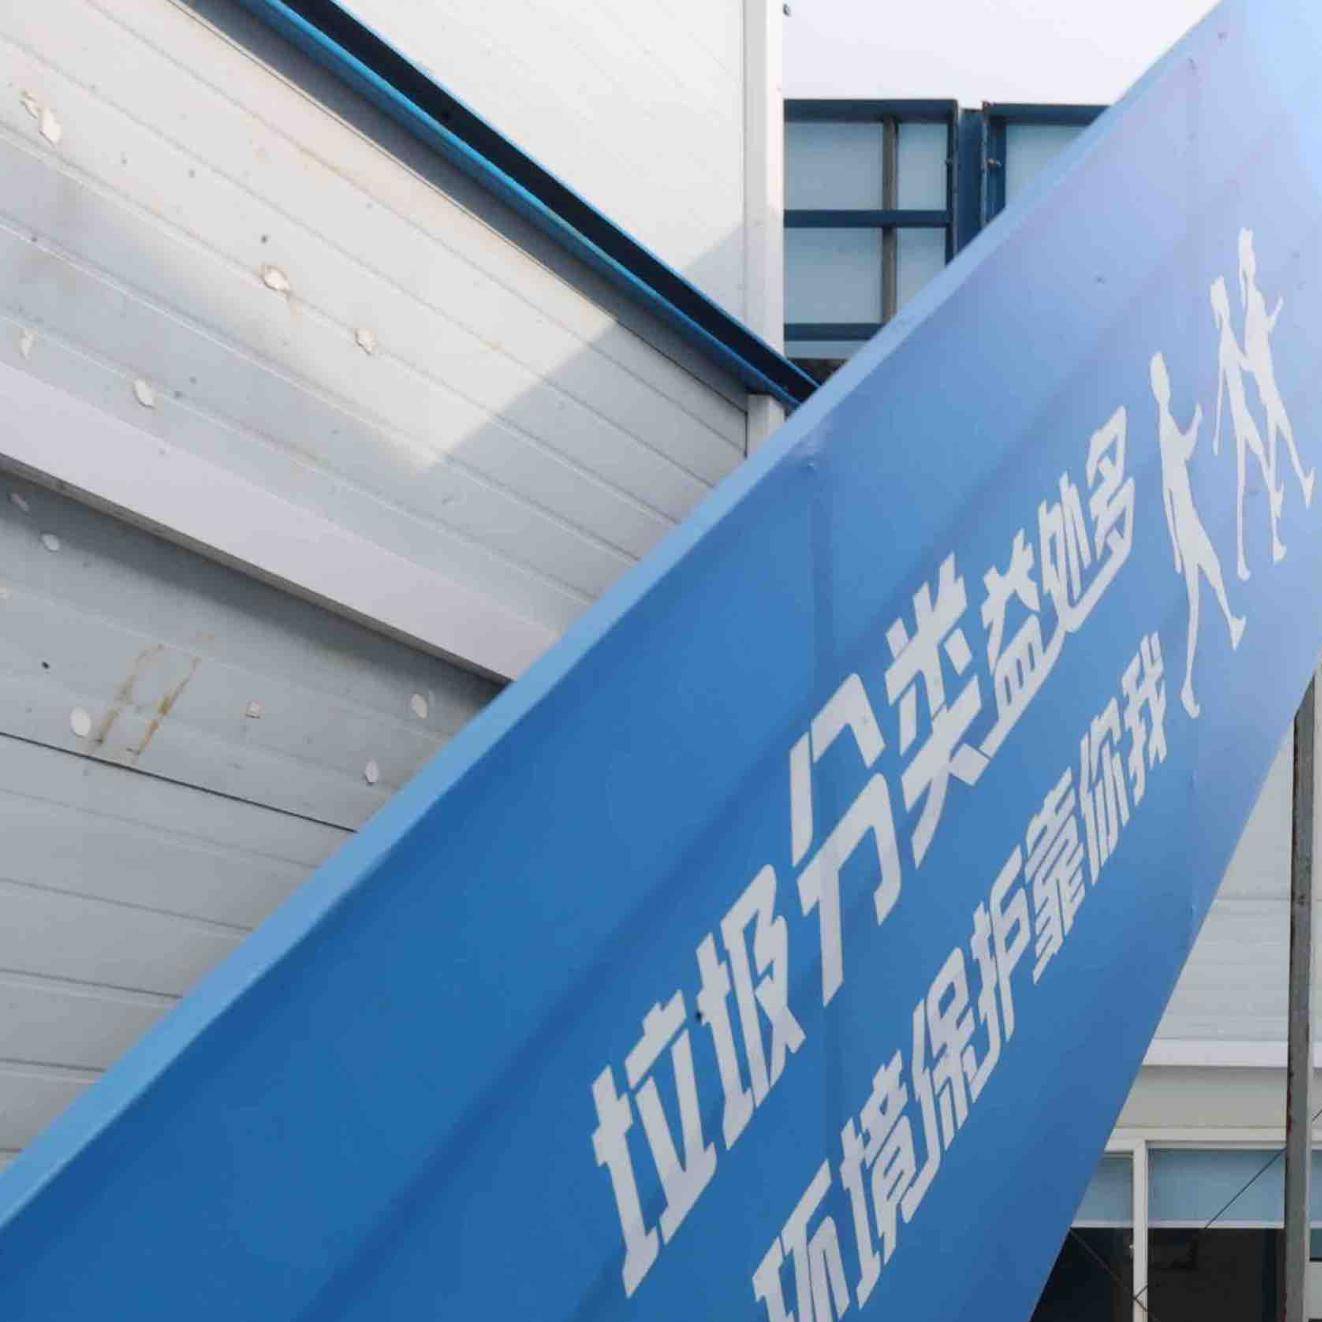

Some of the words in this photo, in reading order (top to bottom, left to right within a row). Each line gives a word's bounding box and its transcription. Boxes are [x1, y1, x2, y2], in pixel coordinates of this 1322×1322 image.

[592, 405, 1137, 1298] 垃圾分类益处多
